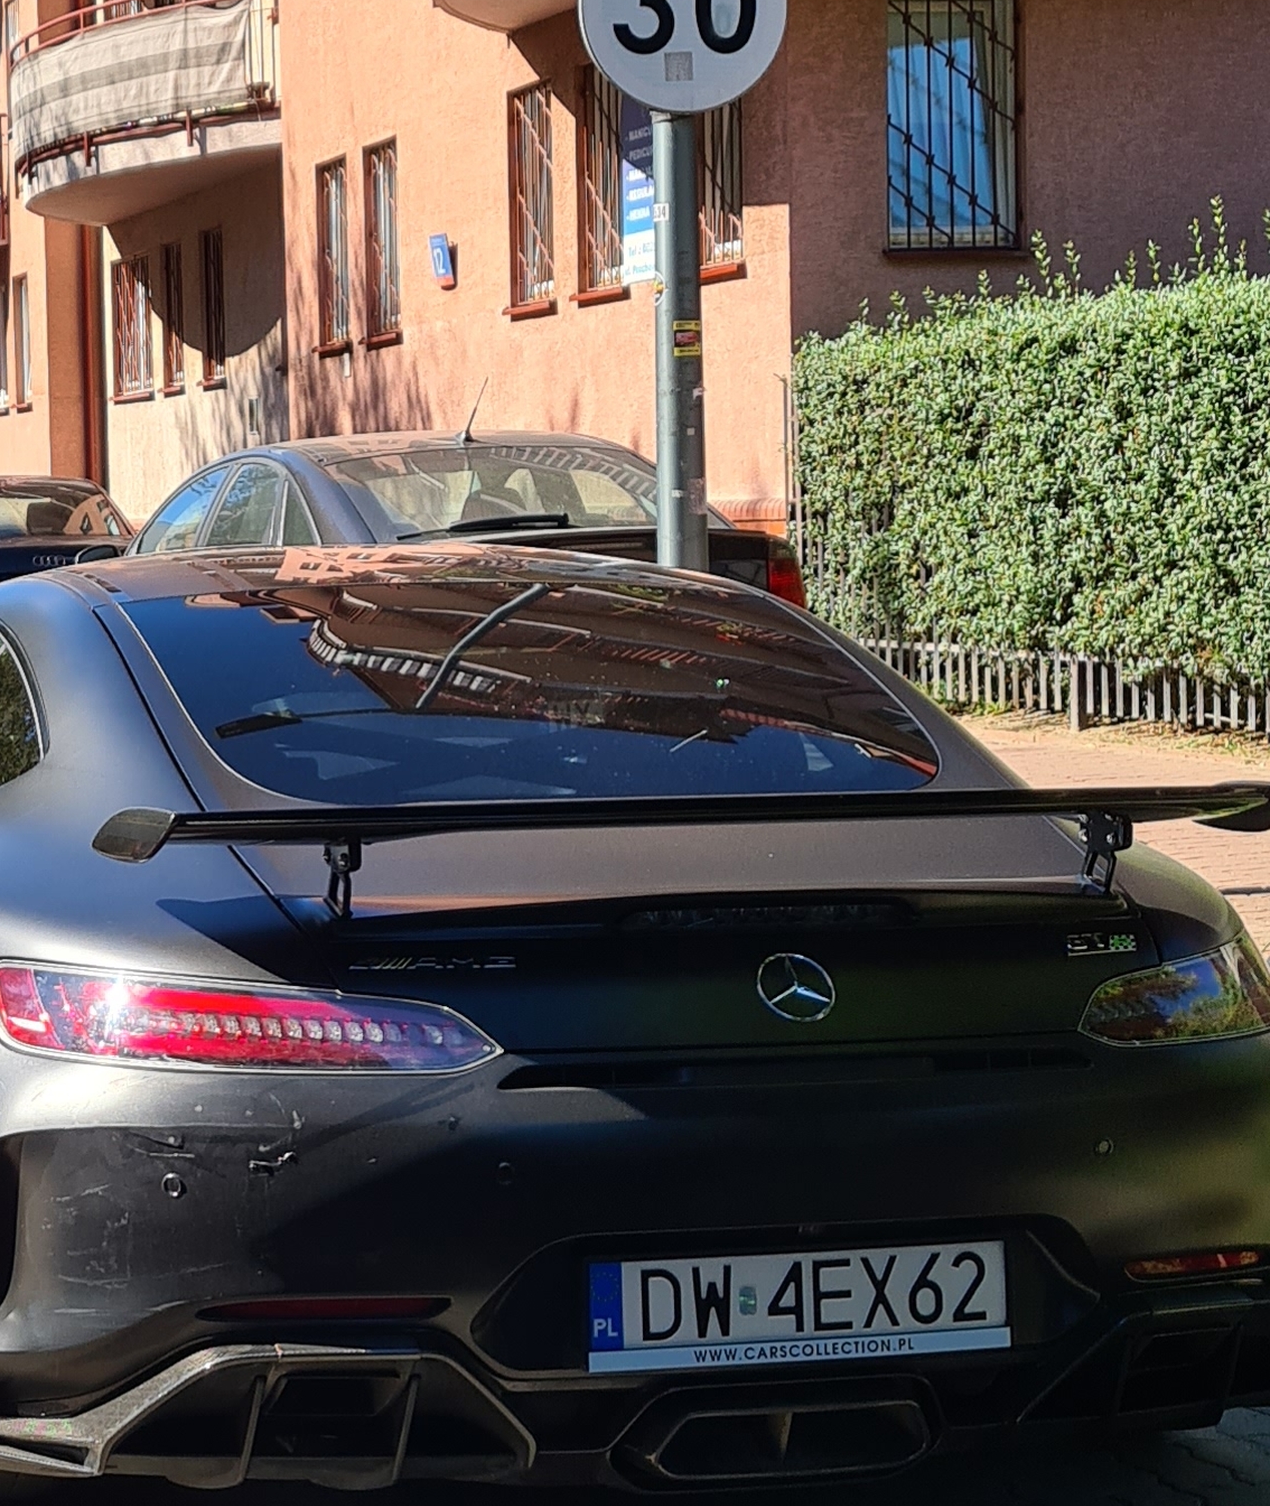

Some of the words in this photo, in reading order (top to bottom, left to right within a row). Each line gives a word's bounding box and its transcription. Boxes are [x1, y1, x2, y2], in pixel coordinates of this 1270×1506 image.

[639, 1264, 732, 1342] DW
[766, 1251, 988, 1333] 4EX62
[593, 1317, 619, 1338] PL
[692, 1337, 916, 1364] WWW.CARSCOLLECTION.PL
